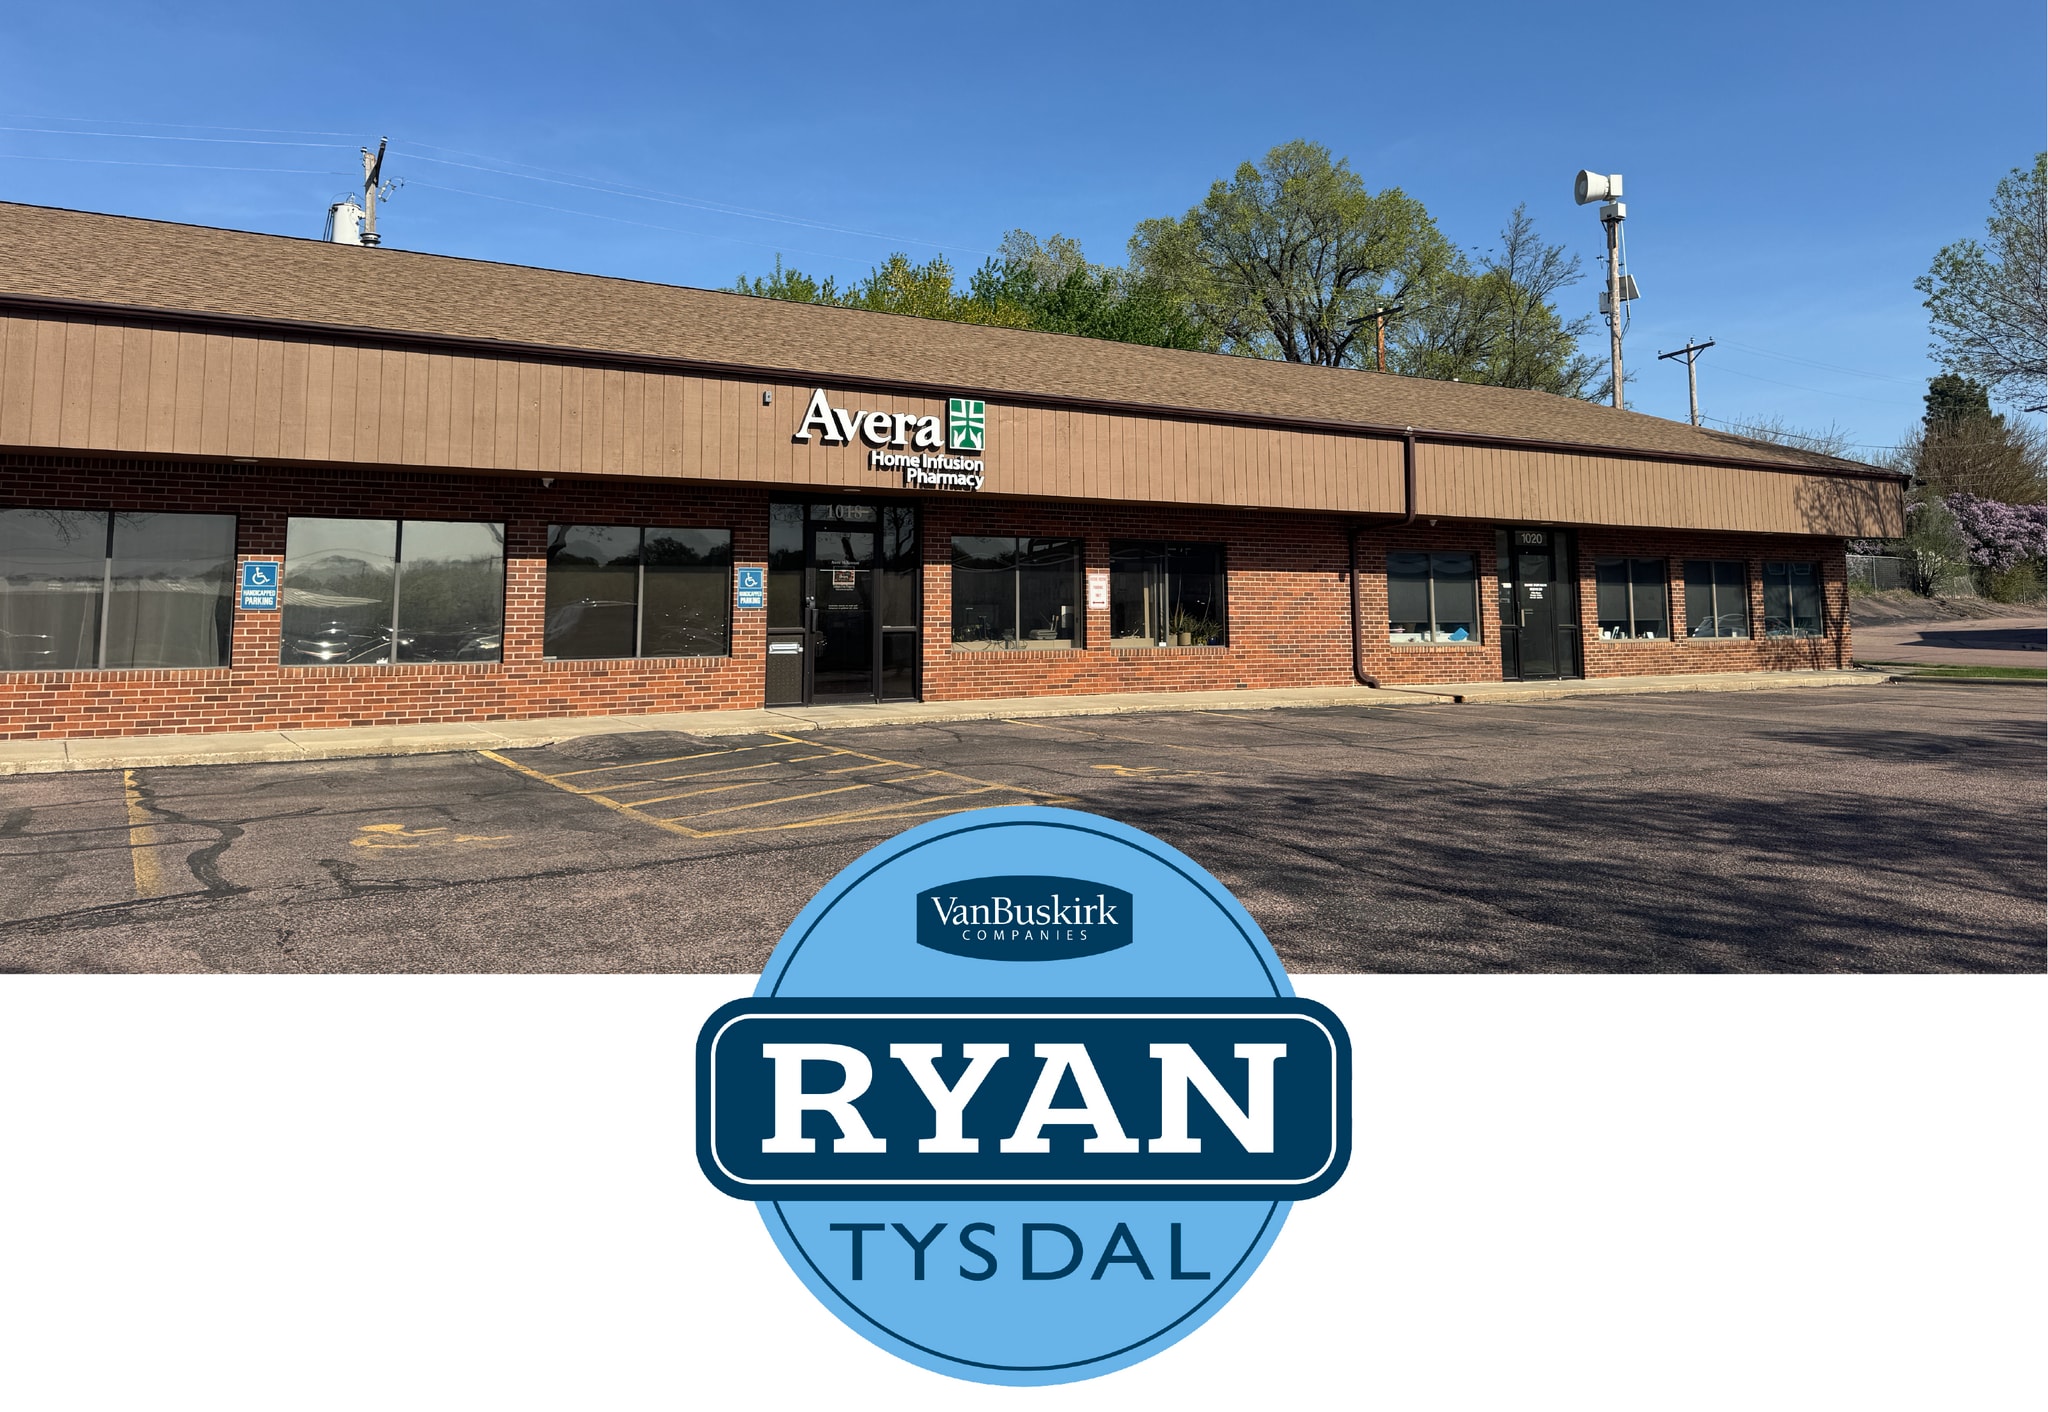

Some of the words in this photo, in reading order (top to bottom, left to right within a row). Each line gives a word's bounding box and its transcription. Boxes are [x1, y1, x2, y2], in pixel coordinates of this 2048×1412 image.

[796, 388, 945, 447] Avera
[871, 450, 920, 468] Home
[922, 453, 984, 472] Infusion
[907, 468, 985, 490] Pharmacy
[827, 504, 862, 519] 1018
[1521, 533, 1543, 545] 1020
[243, 589, 276, 597] HANDICAPPED
[244, 597, 274, 606] PARKING
